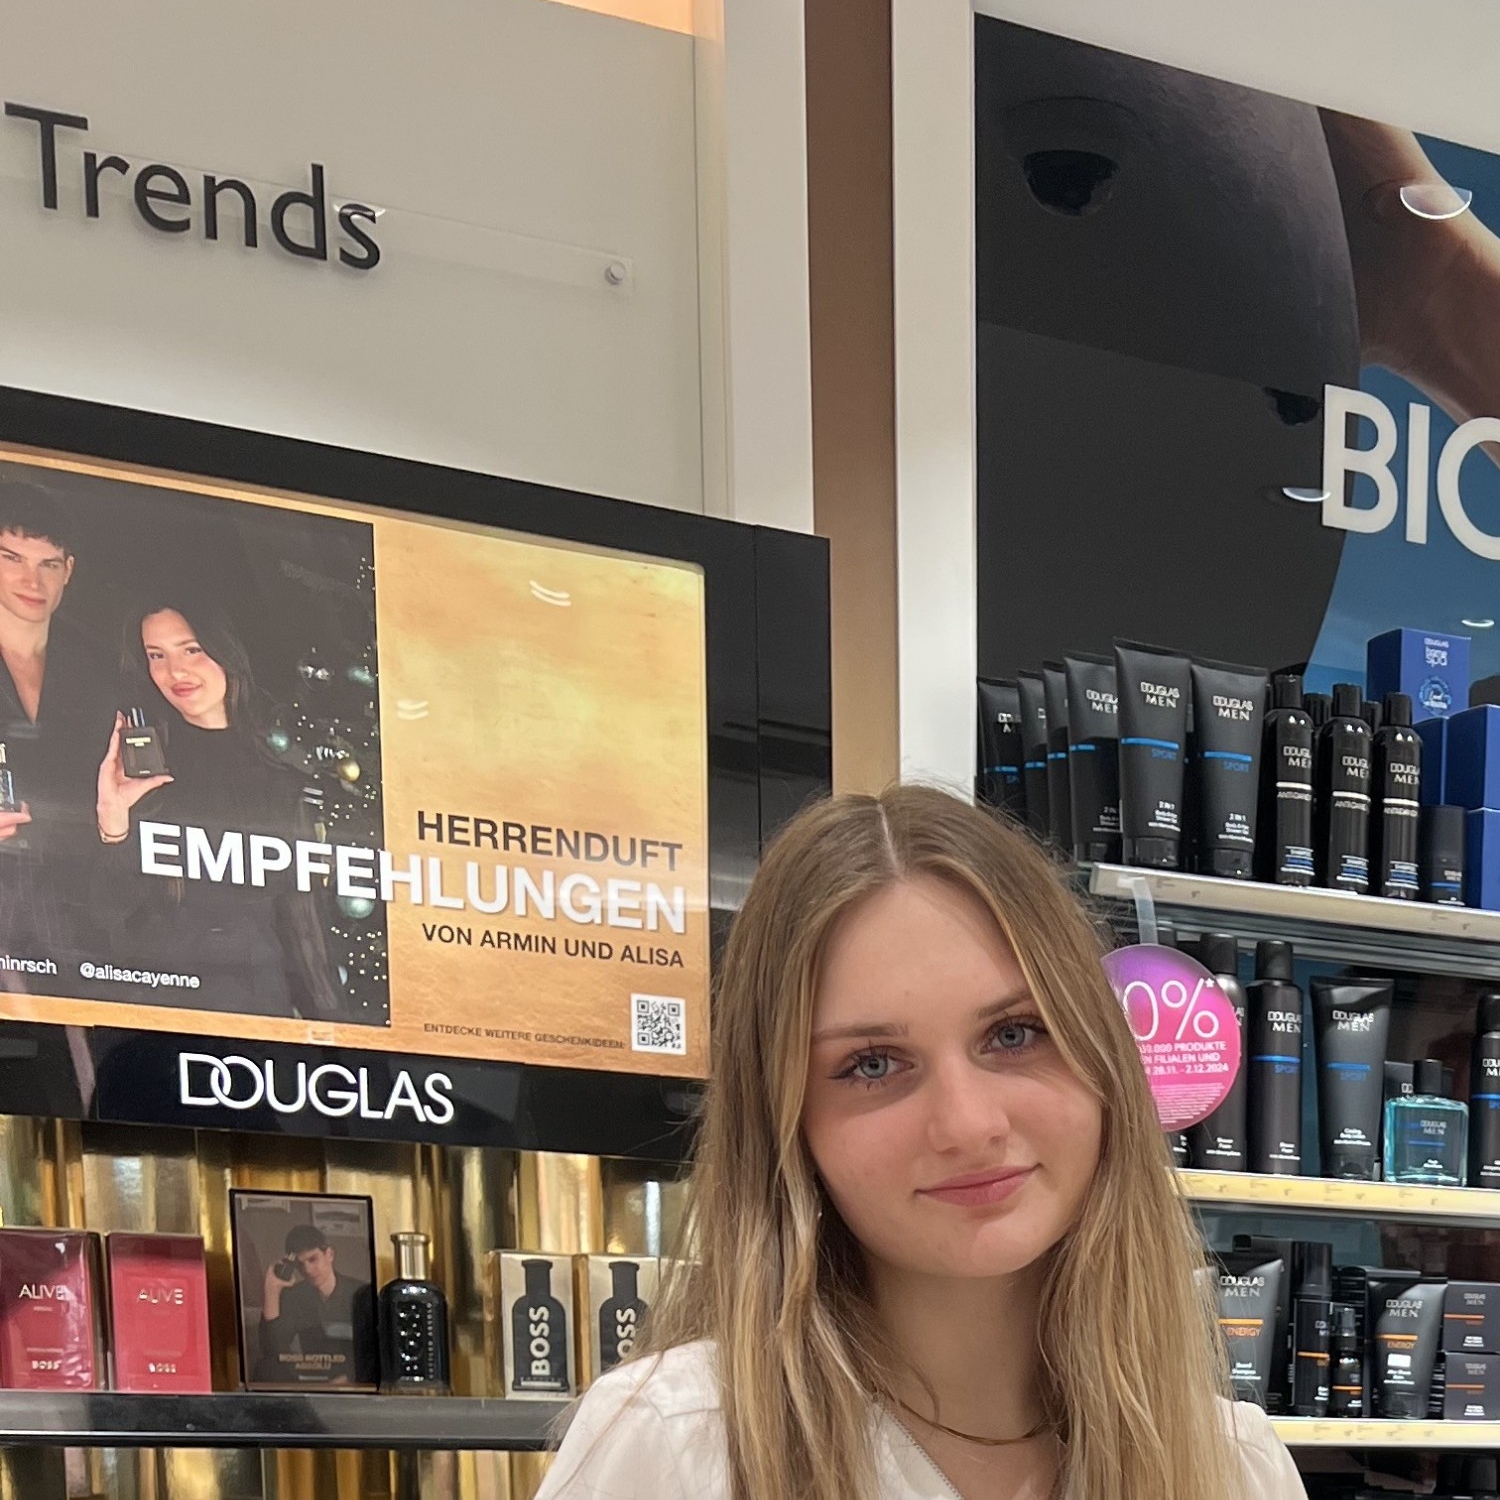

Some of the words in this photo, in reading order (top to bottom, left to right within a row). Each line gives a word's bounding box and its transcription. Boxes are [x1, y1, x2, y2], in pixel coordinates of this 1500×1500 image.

[5, 102, 382, 270] Trends
[1141, 682, 1180, 698] DOUGLAS
[1146, 694, 1177, 708] MEN
[1213, 695, 1254, 711] DOUGLAS
[1218, 707, 1250, 720] MEN
[417, 810, 684, 872] HERRENDUFT
[139, 820, 686, 935] EMPFEHLUNGEN
[422, 923, 473, 946] VON
[480, 929, 556, 955] ARMIN
[564, 938, 613, 961] UND
[620, 945, 684, 968] ALISA
[80, 962, 201, 989] @alisacayenne
[1332, 1010, 1375, 1023] DOUGLAS
[424, 1023, 482, 1037] ENTDECKE
[485, 1027, 532, 1042] WEITERE
[1337, 1021, 1370, 1033] MEN
[1174, 1041, 1227, 1052] PRODUKTE
[178, 1051, 455, 1124] DOUGLAS
[19, 1284, 66, 1300] ALIVE
[137, 1288, 184, 1305] ALIVE
[1224, 1287, 1261, 1297] MEN
[1386, 1299, 1424, 1309] DOUGLAS
[1389, 1308, 1419, 1318] MEN
[529, 1305, 551, 1376] BOSS
[616, 1307, 637, 1359] OSS
